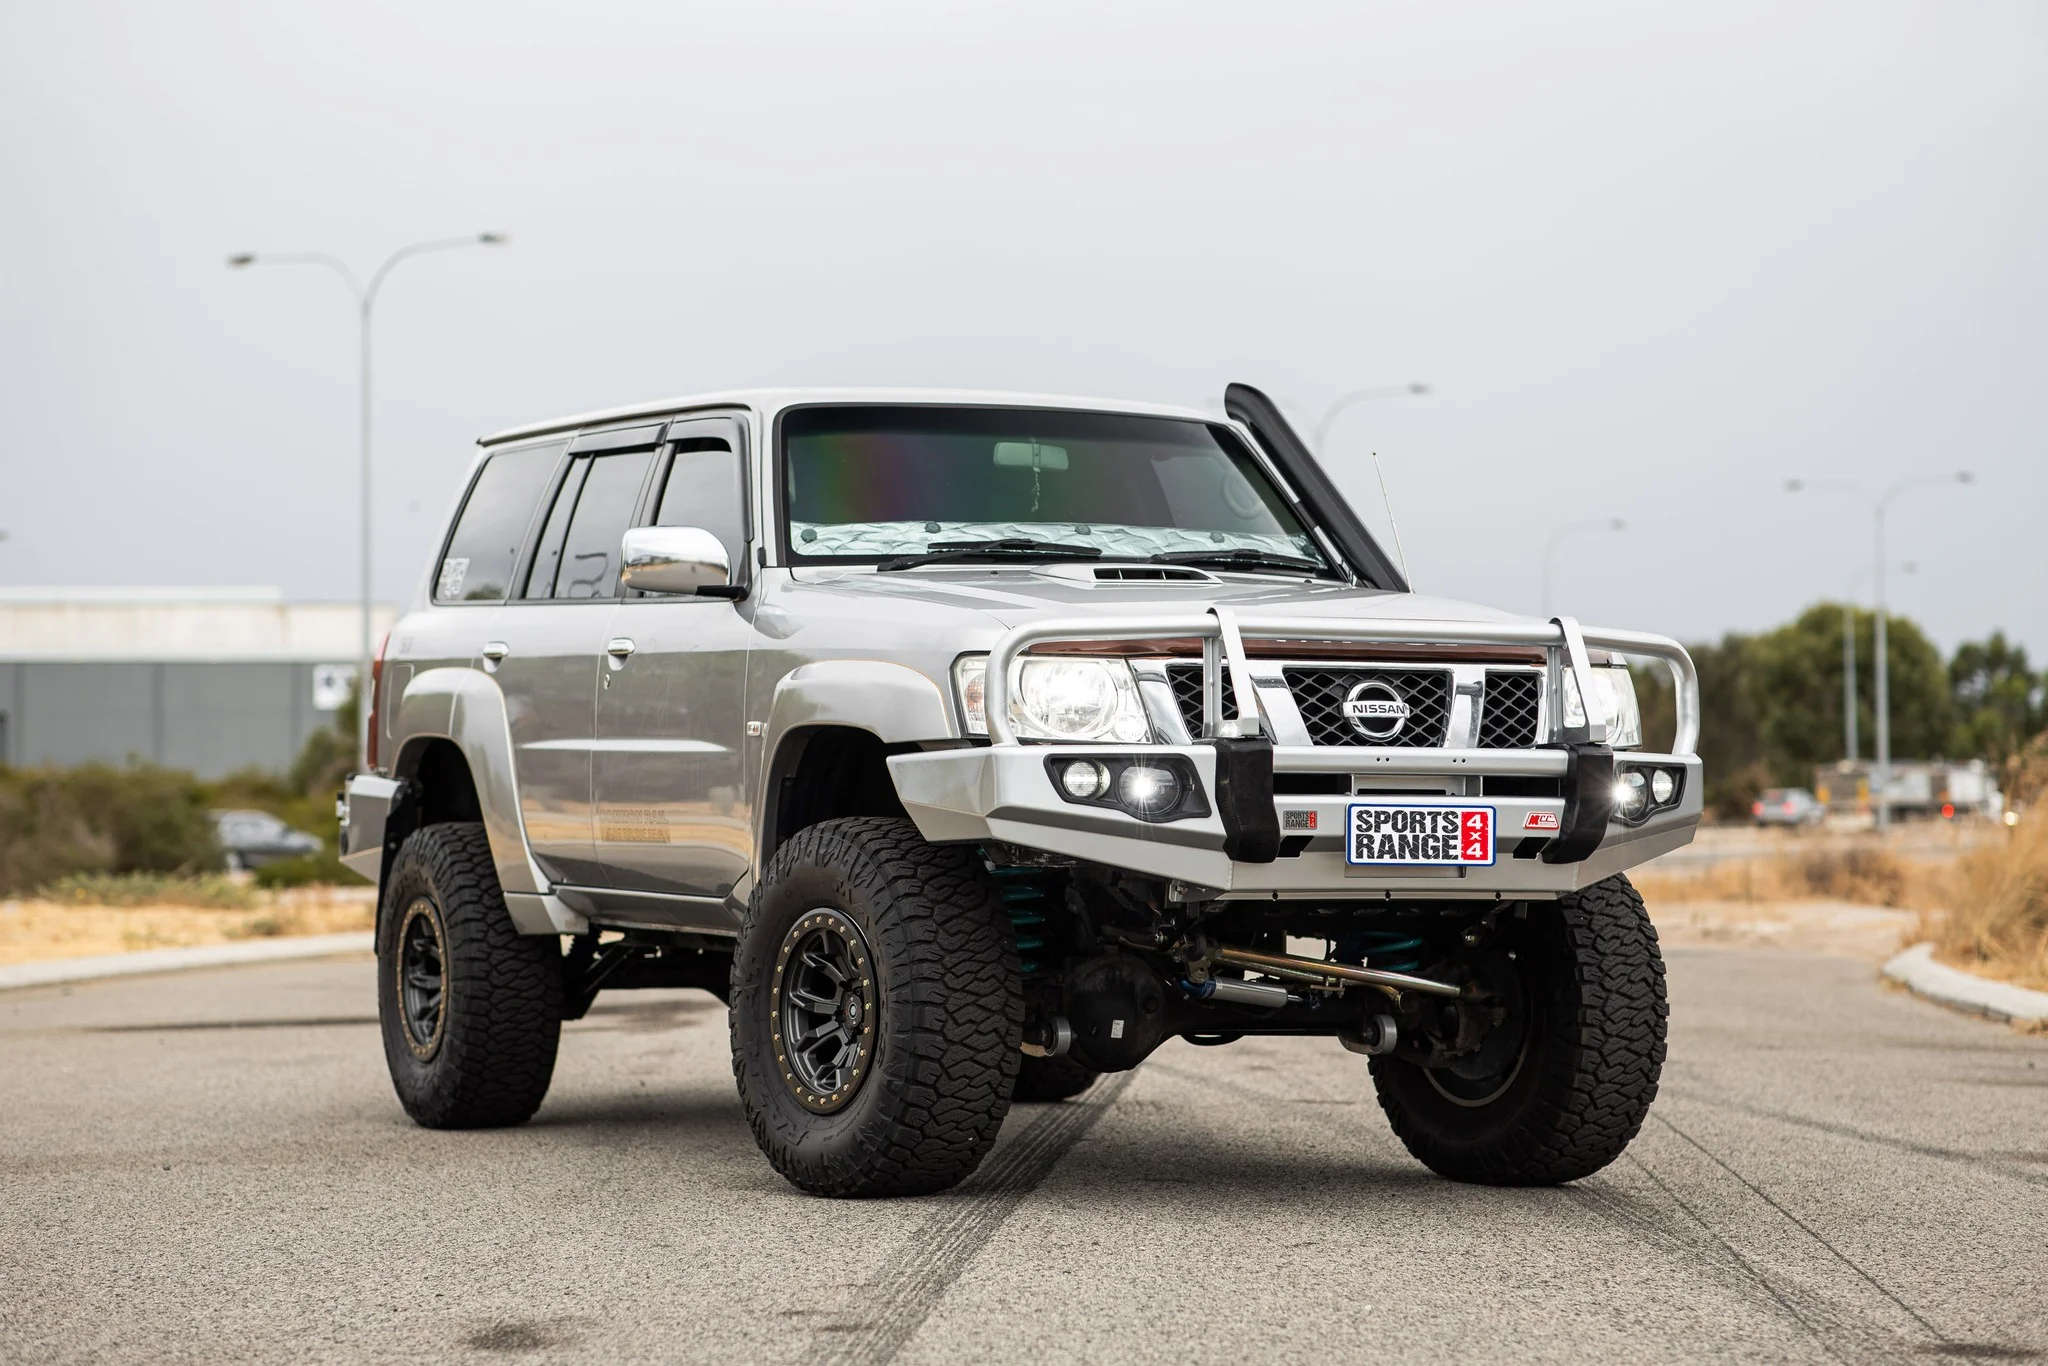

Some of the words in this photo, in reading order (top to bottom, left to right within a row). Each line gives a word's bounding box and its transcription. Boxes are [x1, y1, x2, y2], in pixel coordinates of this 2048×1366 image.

[1352, 704, 1405, 715] NISSAN
[1285, 811, 1309, 820] SPORTS
[1285, 820, 1309, 828] RANGE
[1356, 810, 1459, 834] SPORTS
[1355, 834, 1459, 859] RANGE
